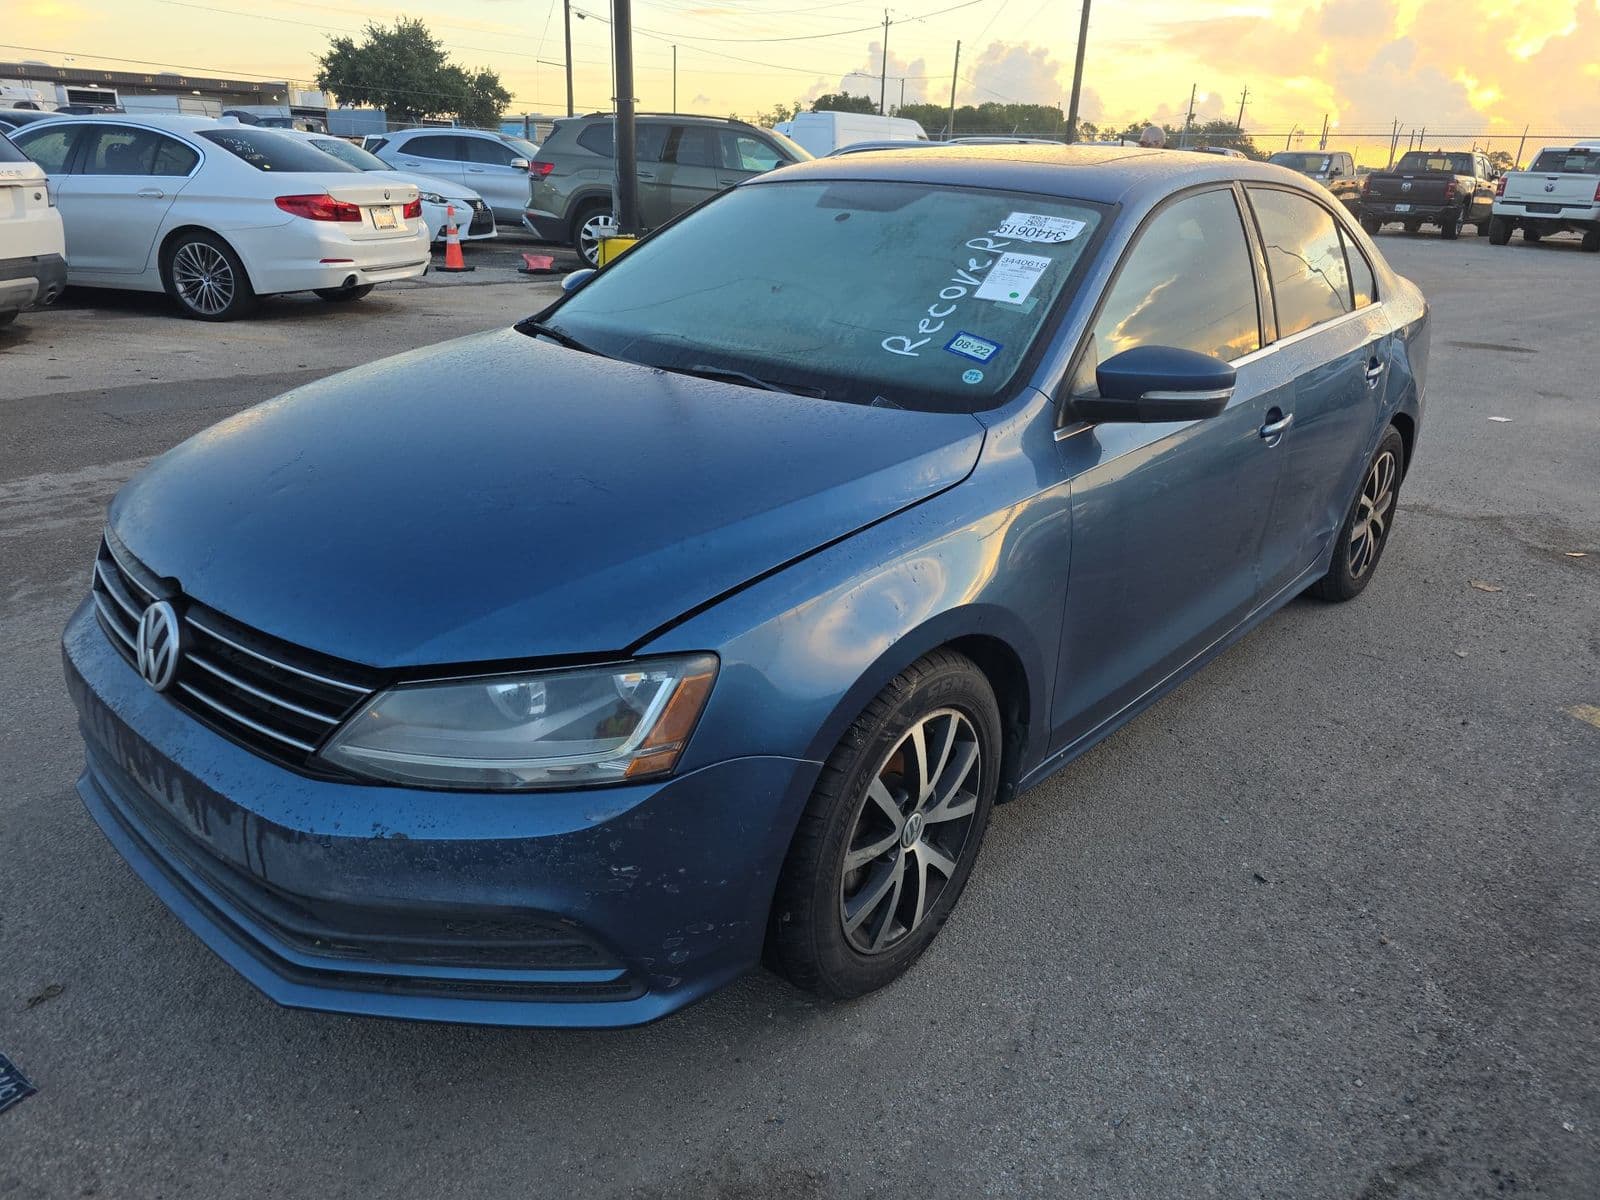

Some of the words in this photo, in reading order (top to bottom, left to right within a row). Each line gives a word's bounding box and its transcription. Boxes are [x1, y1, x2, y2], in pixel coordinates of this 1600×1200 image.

[998, 224, 1066, 241] 3440619
[1001, 256, 1048, 269] 3440619
[881, 221, 1014, 357] RecoveR
